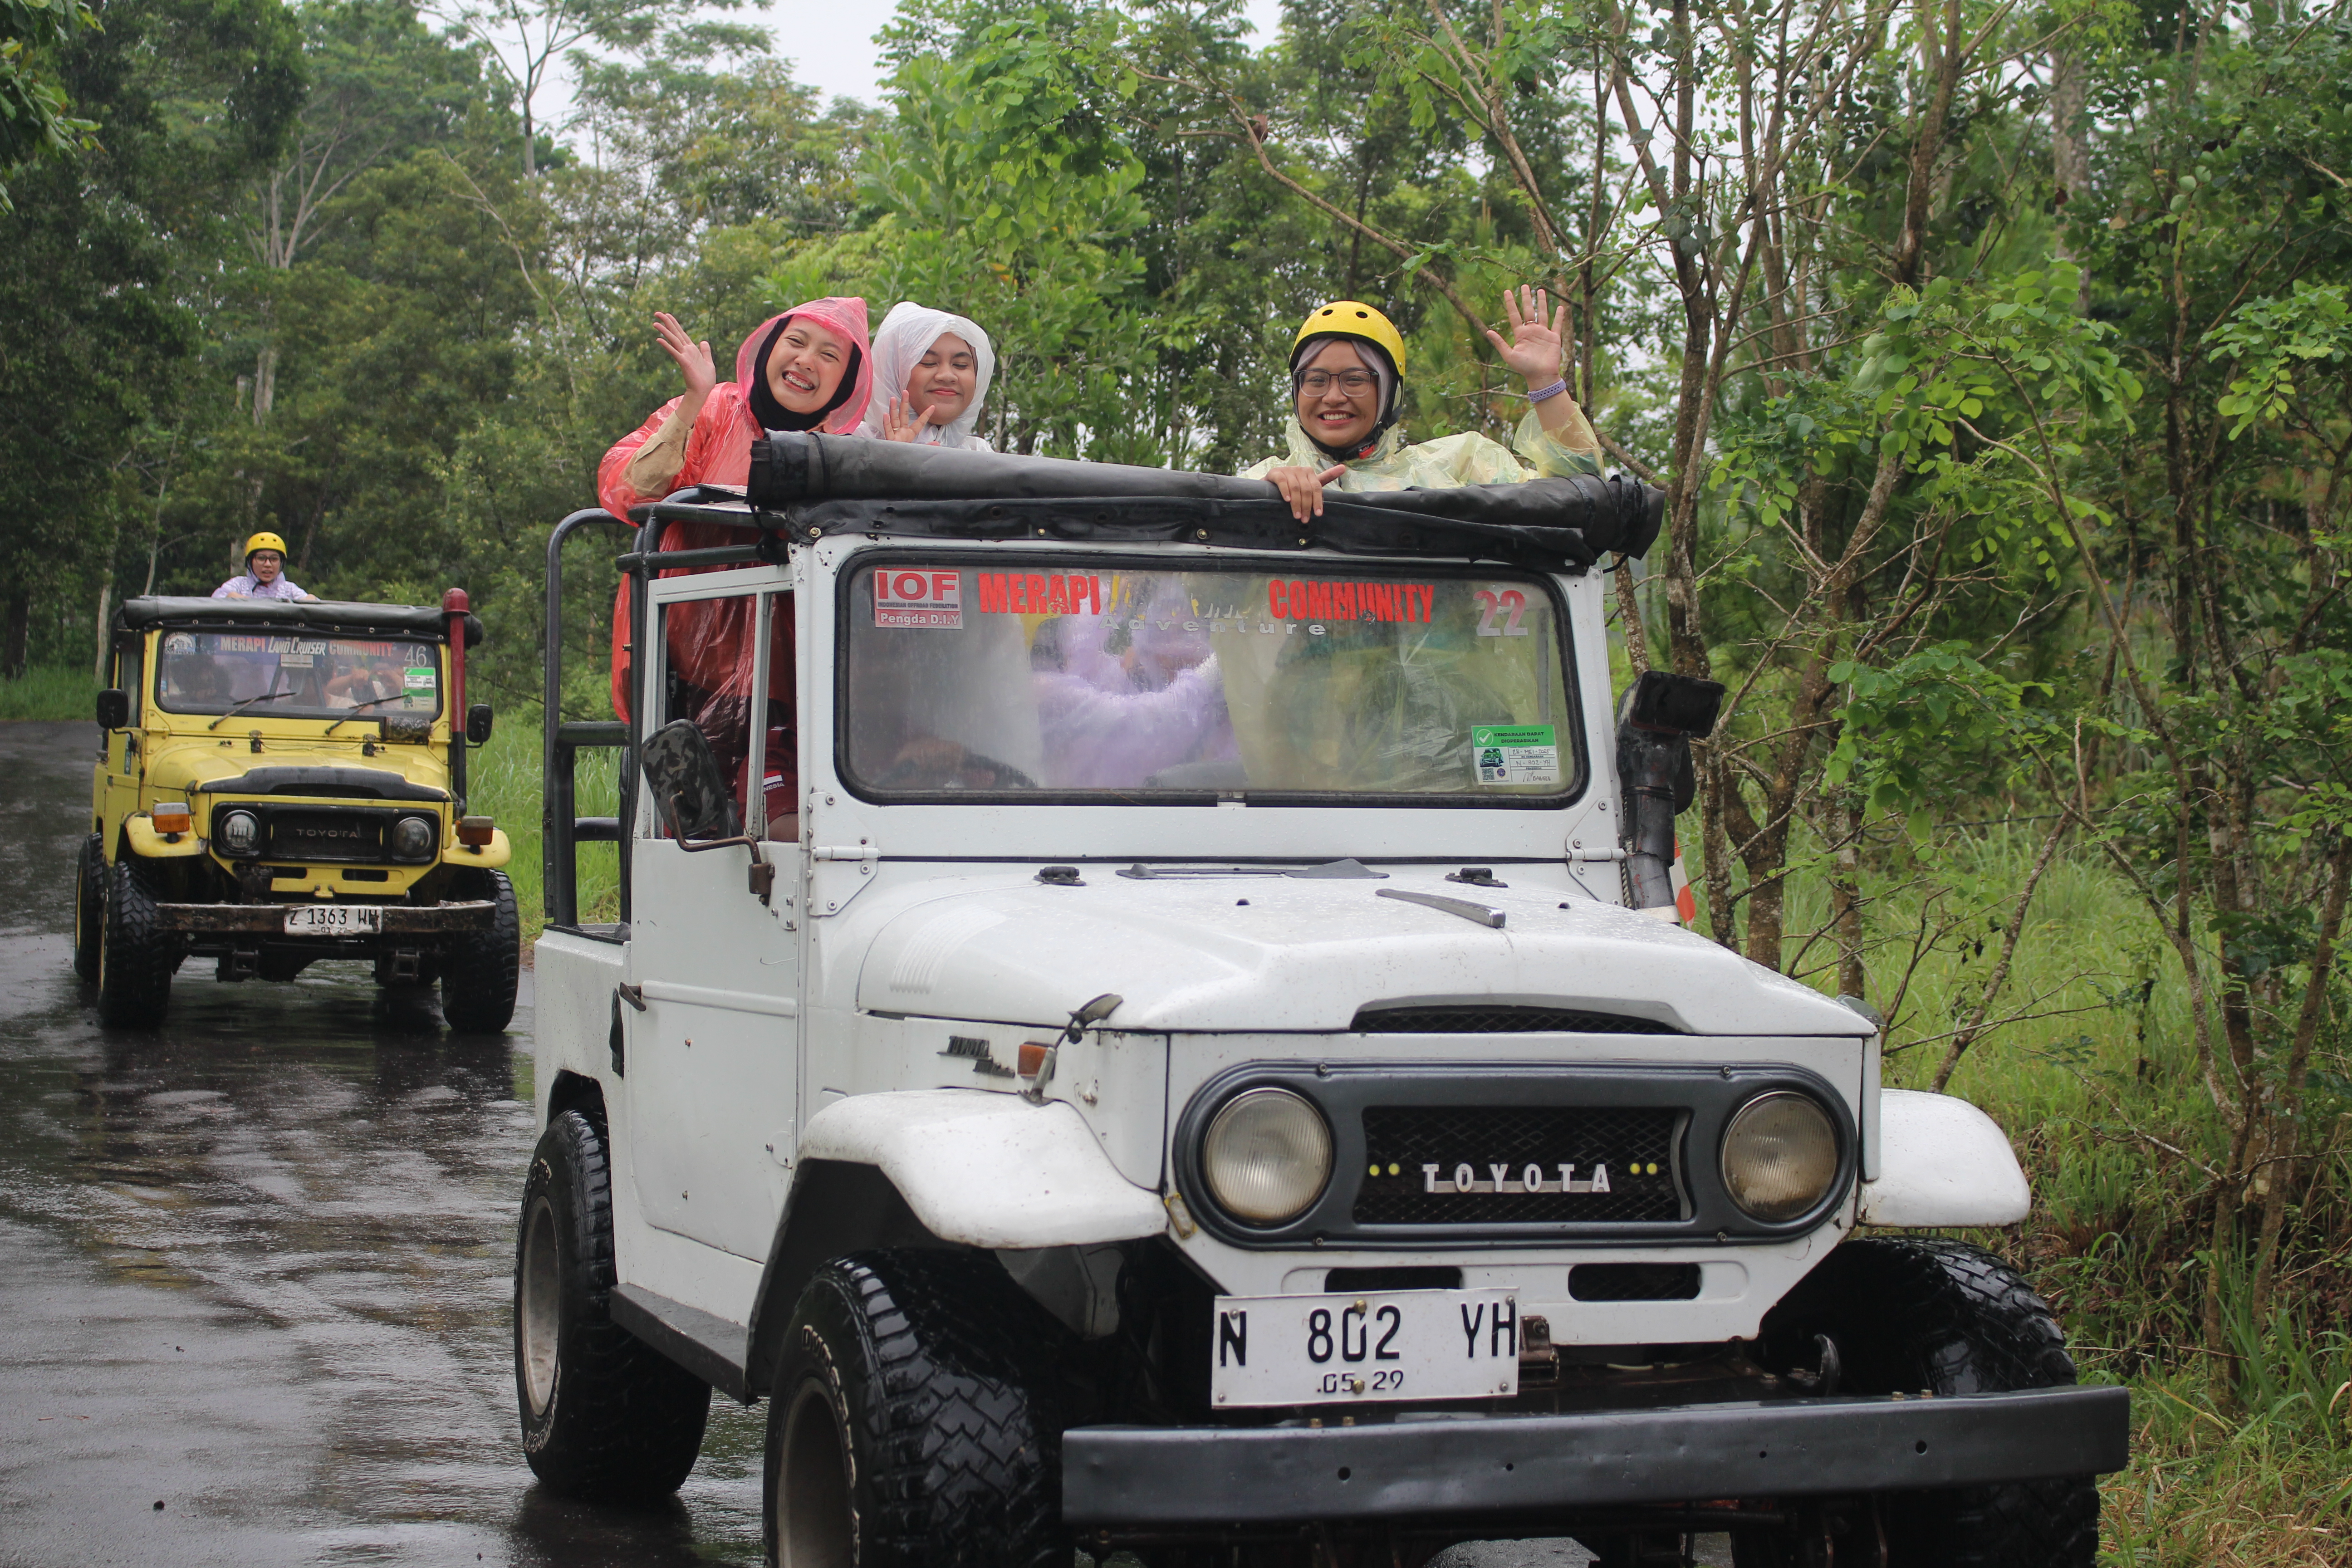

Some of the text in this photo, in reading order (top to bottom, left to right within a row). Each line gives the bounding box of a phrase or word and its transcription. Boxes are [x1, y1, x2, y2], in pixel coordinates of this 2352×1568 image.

[877, 572, 957, 601] IOF
[978, 573, 1101, 615] MERAPI
[1269, 579, 1434, 623] COMMUNITY
[880, 612, 960, 626] Pengda D.I.Y
[1472, 589, 1529, 636] 22
[1098, 615, 1326, 636] Adventure
[220, 636, 393, 657] MERAPI LAND CRUISER COMMUNITY
[404, 645, 427, 667] 46
[296, 829, 358, 838] TOYOTA
[289, 910, 298, 925] Z
[307, 908, 348, 925] 1363
[1422, 1163, 1611, 1193] TOYOTA
[1220, 1303, 1516, 1367] N 802 YH
[1372, 1370, 1404, 1390] 29
